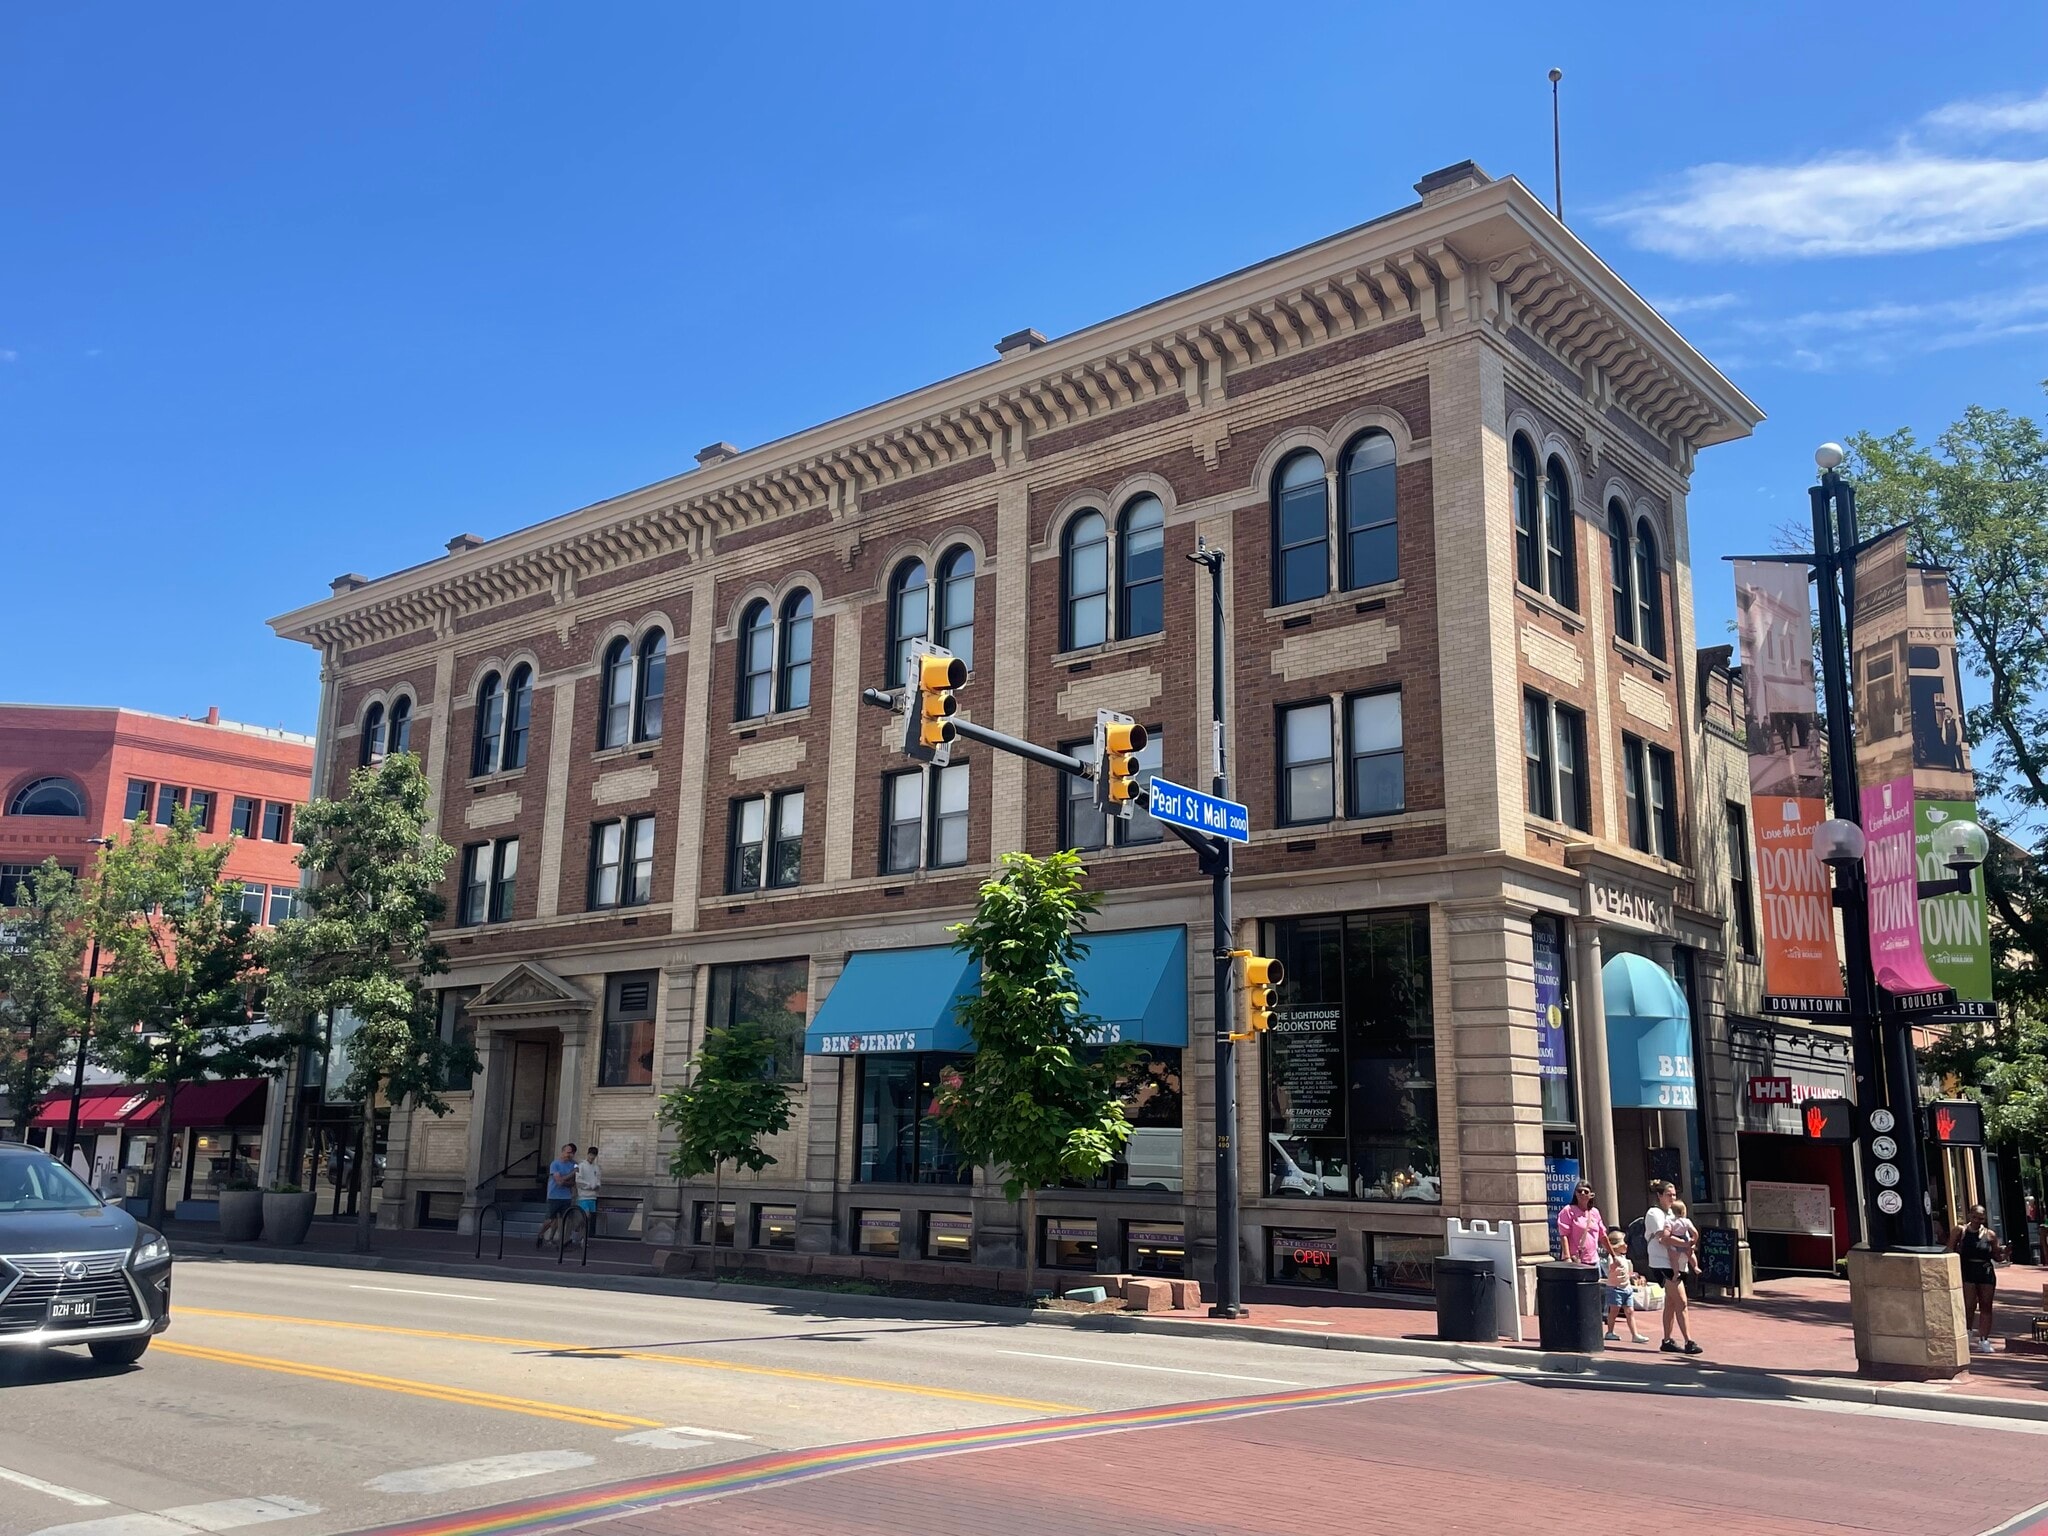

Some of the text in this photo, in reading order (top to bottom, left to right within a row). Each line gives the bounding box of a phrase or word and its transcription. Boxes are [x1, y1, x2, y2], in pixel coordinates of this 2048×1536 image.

[1152, 785, 1247, 831] Pearl St Mall 2000
[1761, 826, 1782, 840] Love
[1782, 823, 1796, 838] the
[1915, 833, 1931, 844] ove
[1868, 829, 1913, 885] DOWN
[1761, 847, 1827, 893] DOWN
[1608, 888, 1657, 924] BANK
[1871, 878, 1915, 934] TOWN
[1764, 893, 1830, 942] TOWN
[1917, 899, 1982, 946] TOWN
[1772, 998, 1843, 1012] DOWNTOWN
[1902, 993, 1945, 1009] BOULDER
[1290, 1010, 1340, 1020] LIGHTHOUSE
[1277, 1020, 1337, 1032] BOOKSTORE
[822, 1031, 915, 1053] BEN JERRY'S
[1755, 1081, 1787, 1099] HH
[1546, 1174, 1576, 1182] HOUSE
[1547, 1183, 1570, 1191] LDER
[1275, 1240, 1335, 1249] ASTROLOGY
[1293, 1249, 1330, 1265] OPEN
